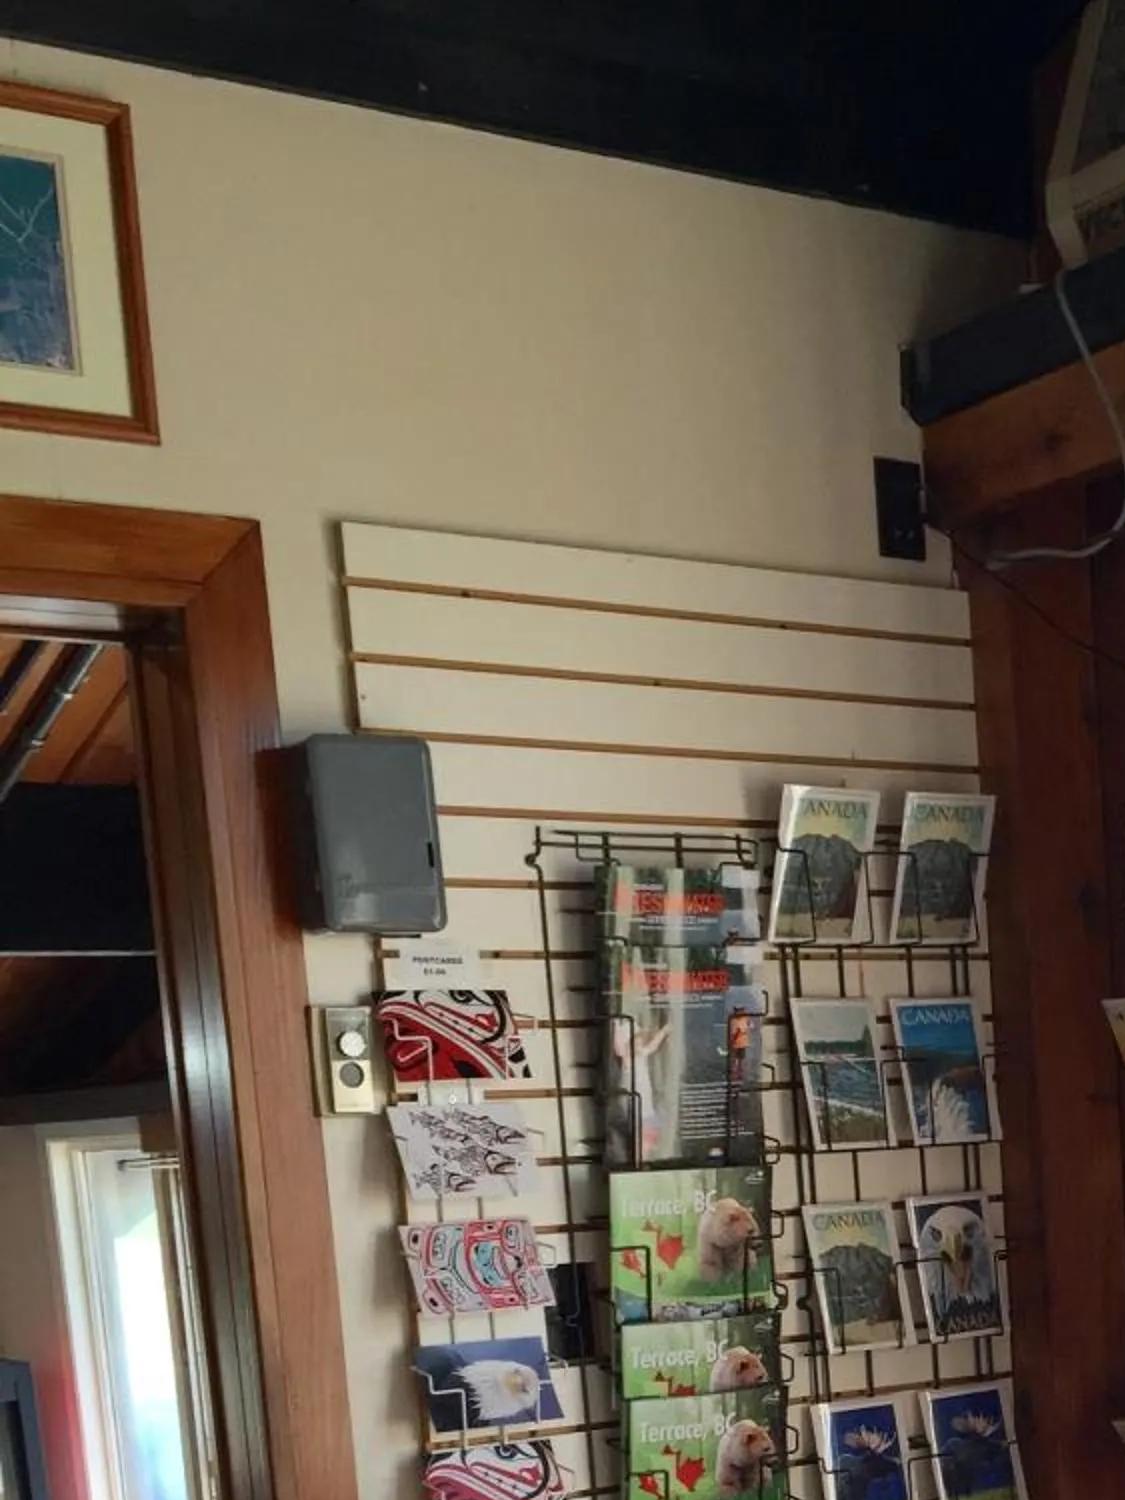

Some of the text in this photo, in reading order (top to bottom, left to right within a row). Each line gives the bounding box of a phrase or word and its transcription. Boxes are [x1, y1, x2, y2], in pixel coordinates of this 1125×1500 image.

[915, 802, 985, 822] CANADA
[901, 1007, 970, 1026] CANADA
[693, 1188, 718, 1215] BC
[812, 1210, 886, 1231] CANADA
[705, 1338, 729, 1362] BC
[713, 1411, 737, 1436] BC
